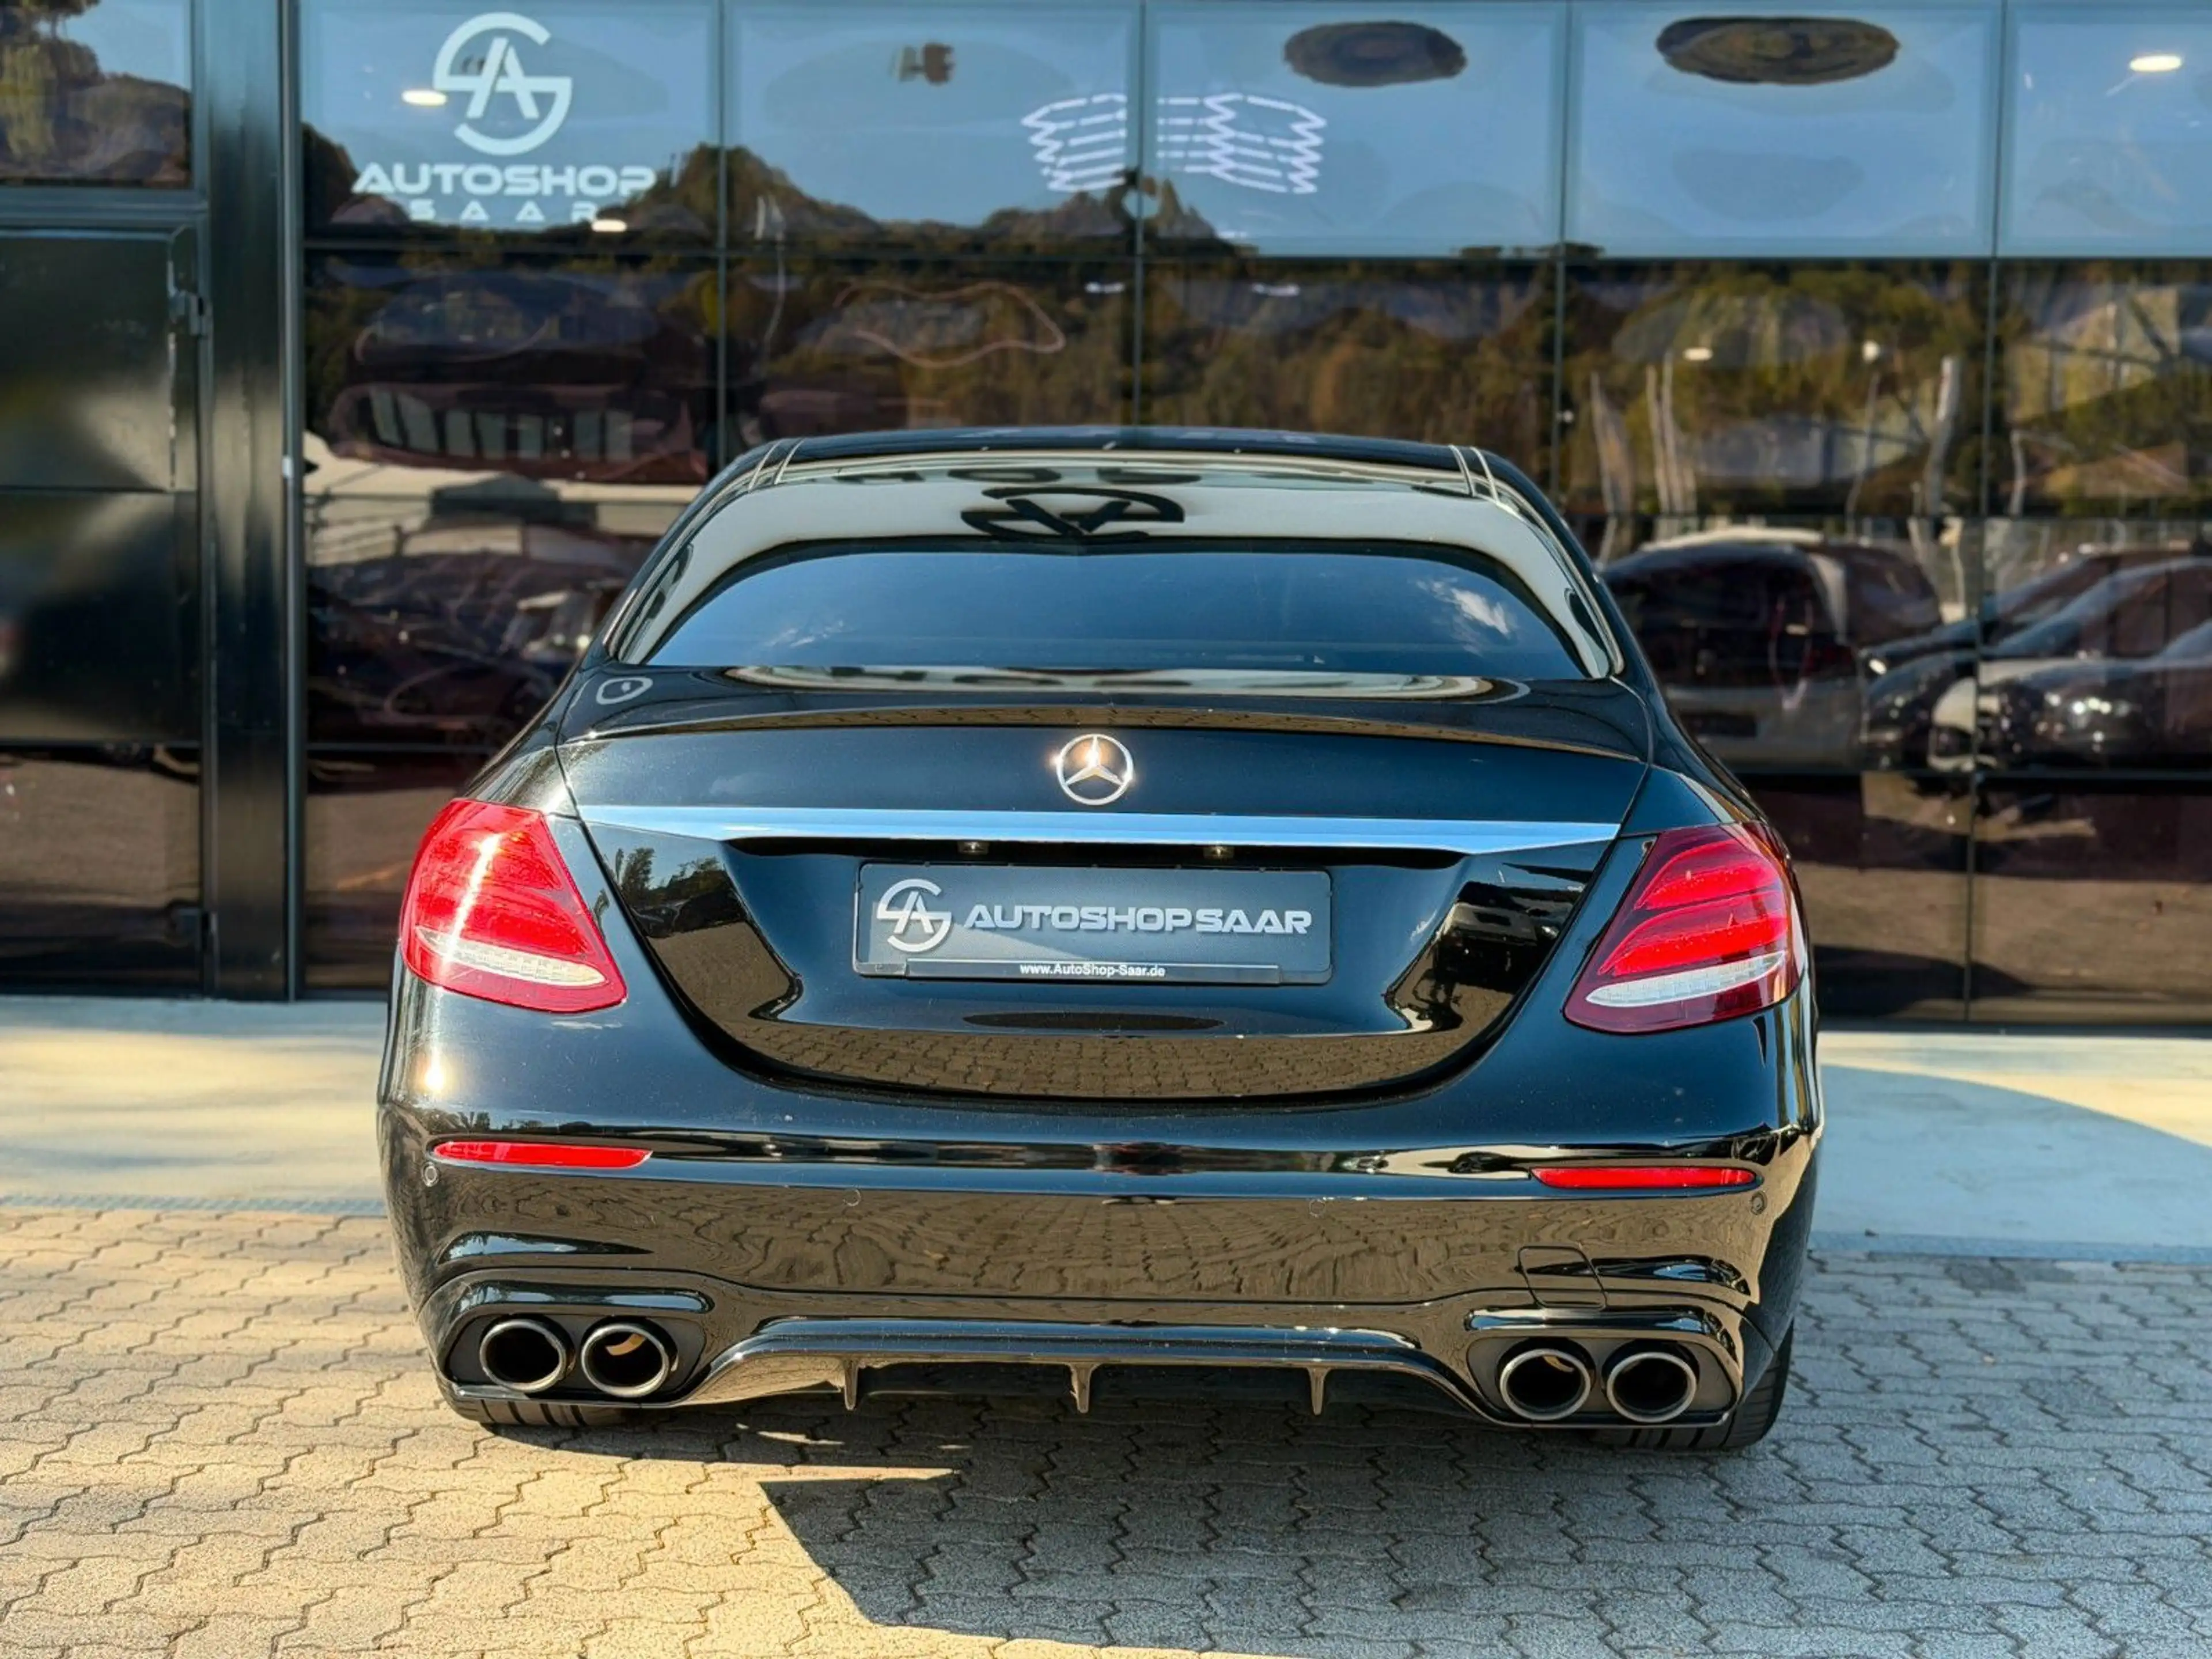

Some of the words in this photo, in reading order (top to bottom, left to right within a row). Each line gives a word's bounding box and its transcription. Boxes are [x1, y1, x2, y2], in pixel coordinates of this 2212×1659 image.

[351, 162, 657, 197] AUTOSHOP
[408, 198, 598, 222] SAAR
[1019, 963, 1166, 978] www.AutoShop-Saar.de
